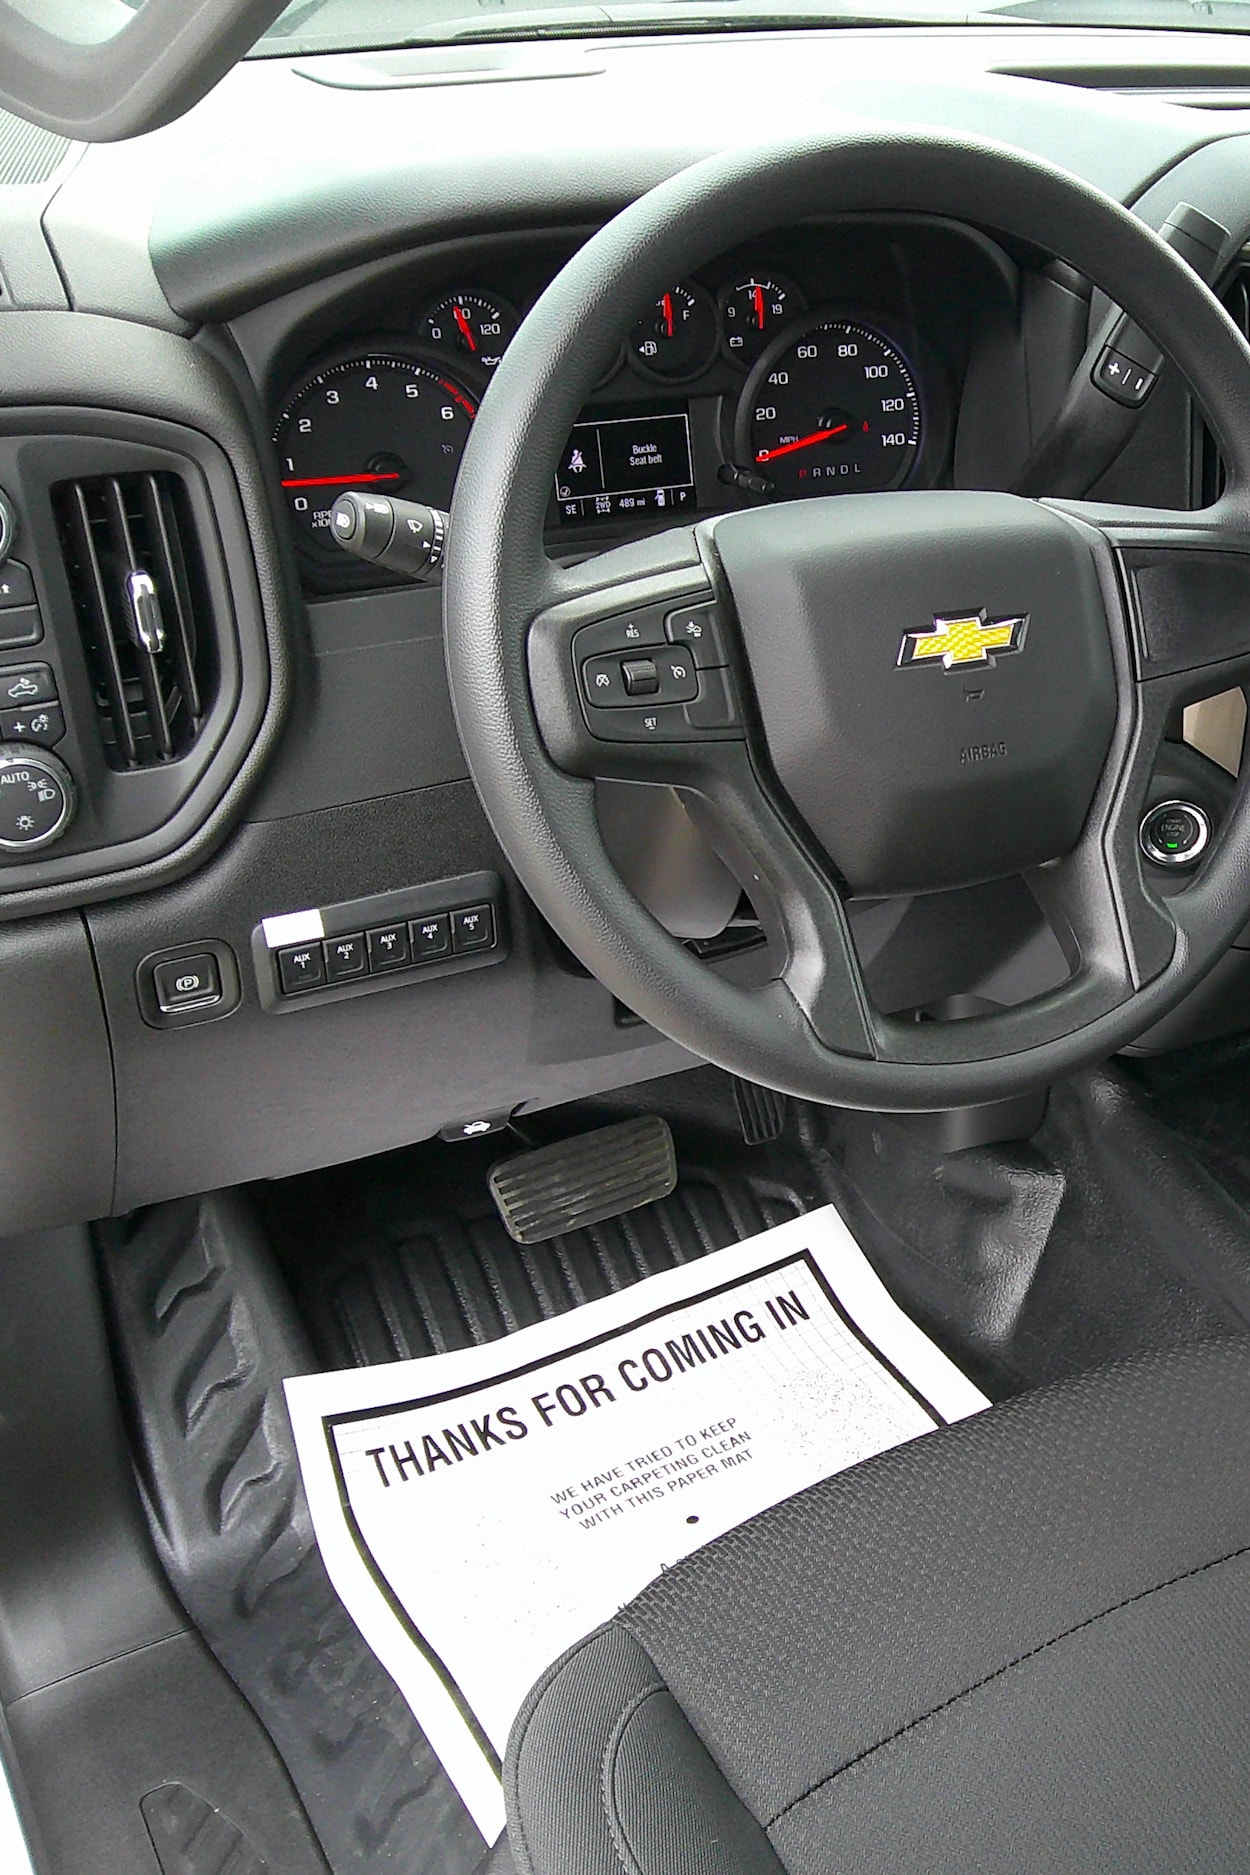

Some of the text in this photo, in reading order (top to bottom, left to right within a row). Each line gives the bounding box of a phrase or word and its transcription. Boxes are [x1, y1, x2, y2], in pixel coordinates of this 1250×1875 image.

[683, 310, 690, 320] F
[728, 307, 736, 318] 9
[772, 304, 783, 315] 19
[432, 328, 441, 340] 0
[480, 323, 501, 336] 120
[797, 344, 818, 360] 60
[837, 343, 858, 358] 80
[768, 371, 789, 386] 40
[864, 364, 888, 380] 100
[365, 376, 379, 390] 4
[326, 390, 340, 405] 3
[405, 384, 419, 398] 5
[881, 398, 905, 413] 120
[440, 407, 454, 420] 6
[755, 406, 776, 421] 20
[299, 419, 312, 433] 2
[779, 435, 799, 444] MPH
[881, 433, 905, 447] 140
[632, 444, 657, 455] Buckle
[286, 457, 294, 471] 1
[629, 453, 663, 466] Seat belt
[812, 467, 821, 477] R
[826, 466, 835, 476] N
[840, 465, 849, 474] D
[854, 463, 861, 473] L
[619, 497, 646, 508] 489 mi
[680, 492, 687, 502] P
[294, 497, 308, 511] 0
[565, 504, 577, 515] SE
[595, 500, 611, 510] 2WD
[625, 628, 640, 638] RES
[644, 717, 657, 727] SET
[960, 741, 1008, 763] AIRBAG
[1, 771, 29, 785] AUTO
[463, 915, 480, 927] AUX
[468, 922, 476, 931] 5
[422, 923, 439, 936] AUX
[427, 931, 435, 940] 4
[380, 932, 397, 946] AUX
[386, 941, 393, 950] 3
[337, 943, 354, 956] AUX
[343, 951, 351, 960] 2
[293, 953, 311, 965] AUX
[300, 961, 307, 969] 1
[365, 1290, 811, 1488] THANKS FOR COMING IN
[550, 1416, 738, 1506] WE HAVE TRIED TO KEEP
[558, 1430, 753, 1521] YOUR CARPETING CLEAN
[578, 1448, 754, 1531] WITH THIS PAPER MAT
